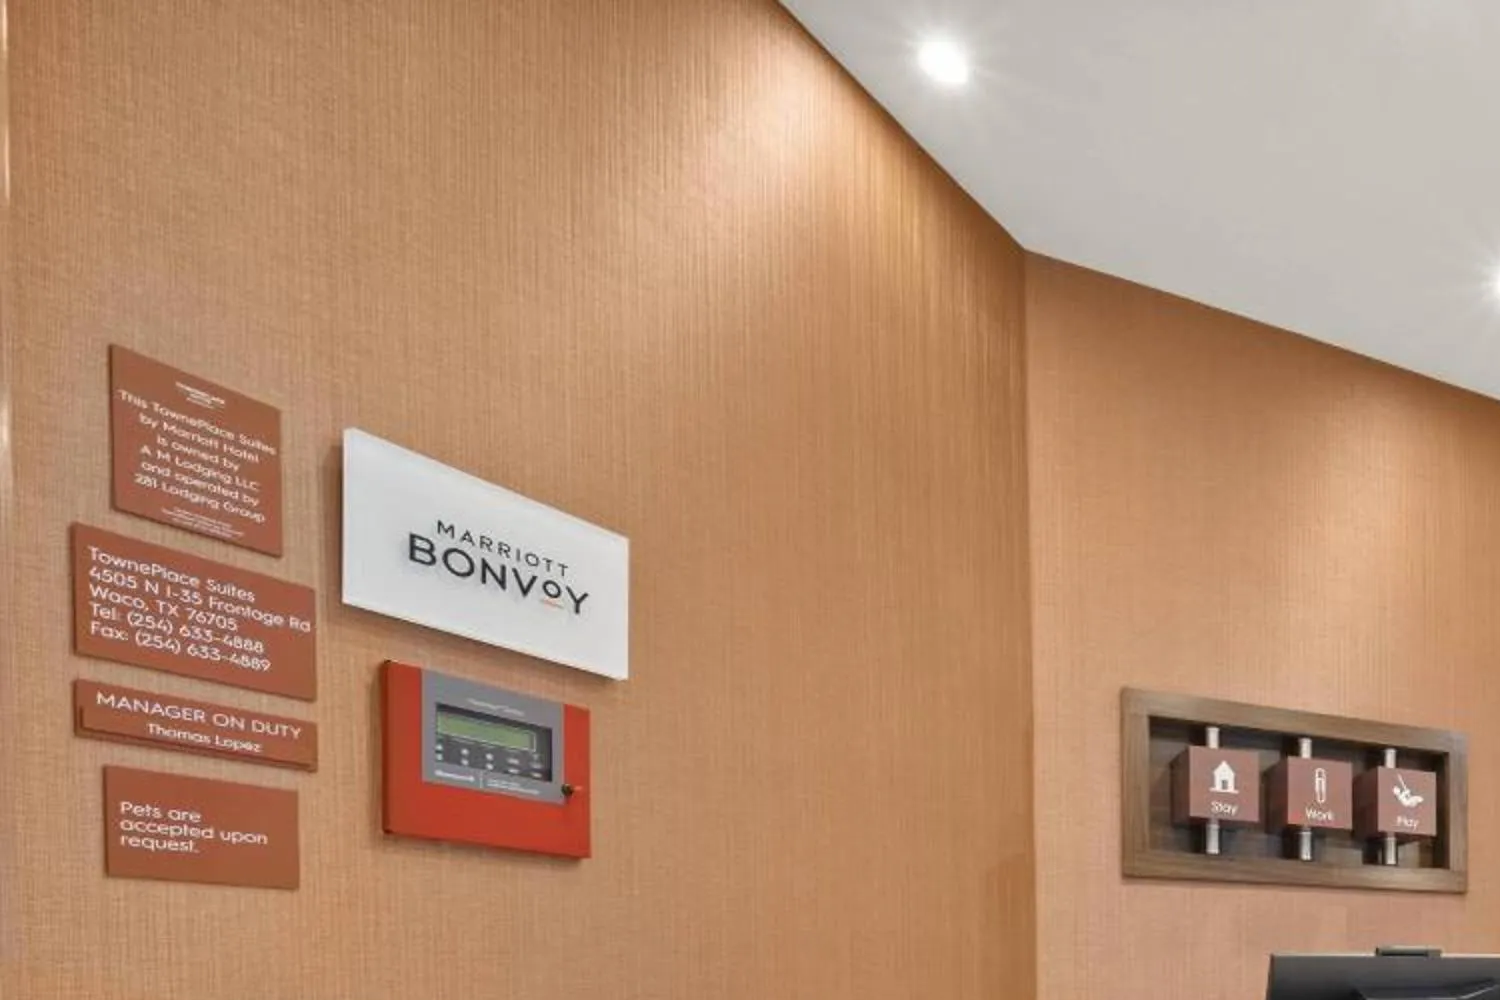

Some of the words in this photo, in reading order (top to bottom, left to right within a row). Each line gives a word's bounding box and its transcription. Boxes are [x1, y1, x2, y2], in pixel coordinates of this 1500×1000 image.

[117, 389, 147, 409] This
[151, 402, 234, 440] TownePlace
[239, 432, 276, 455] Suites
[138, 412, 157, 429] by
[163, 421, 219, 450] Marriott
[140, 444, 151, 456] A
[175, 457, 232, 485] Lodging
[235, 476, 260, 492] LLC
[171, 440, 219, 464] owned
[223, 457, 239, 472] by
[141, 461, 171, 477] and
[175, 473, 239, 499] operated
[243, 493, 259, 507] by
[162, 482, 220, 509] Lodging
[223, 502, 266, 524] Group
[437, 519, 569, 577] MARRIOTT
[87, 546, 200, 587] TownePlace
[206, 578, 256, 602] Suites
[409, 532, 589, 615] BONVOY
[88, 566, 137, 591] 4505
[145, 580, 159, 595] N
[166, 584, 202, 605] I-35
[209, 595, 284, 627] Frontage
[289, 616, 311, 633] Rd
[88, 584, 149, 612] Waco,
[155, 600, 180, 617] TX
[186, 607, 238, 632] 76705
[127, 610, 174, 635] (254)
[179, 624, 264, 654] 633-4888
[135, 629, 181, 655] (254)
[187, 643, 272, 672] 633-4889
[96, 691, 206, 723] MANAGER
[212, 712, 245, 731] ON
[251, 719, 302, 739] DUTY
[147, 722, 210, 745] Thomas
[215, 734, 262, 753] Lopez
[120, 801, 162, 819] Pets
[168, 808, 202, 823] are
[1211, 801, 1239, 816] Stay
[1306, 807, 1335, 821] Work
[1397, 816, 1420, 829] Play
[120, 817, 214, 840] accepted
[220, 829, 268, 846] upon
[120, 834, 200, 853] request.
